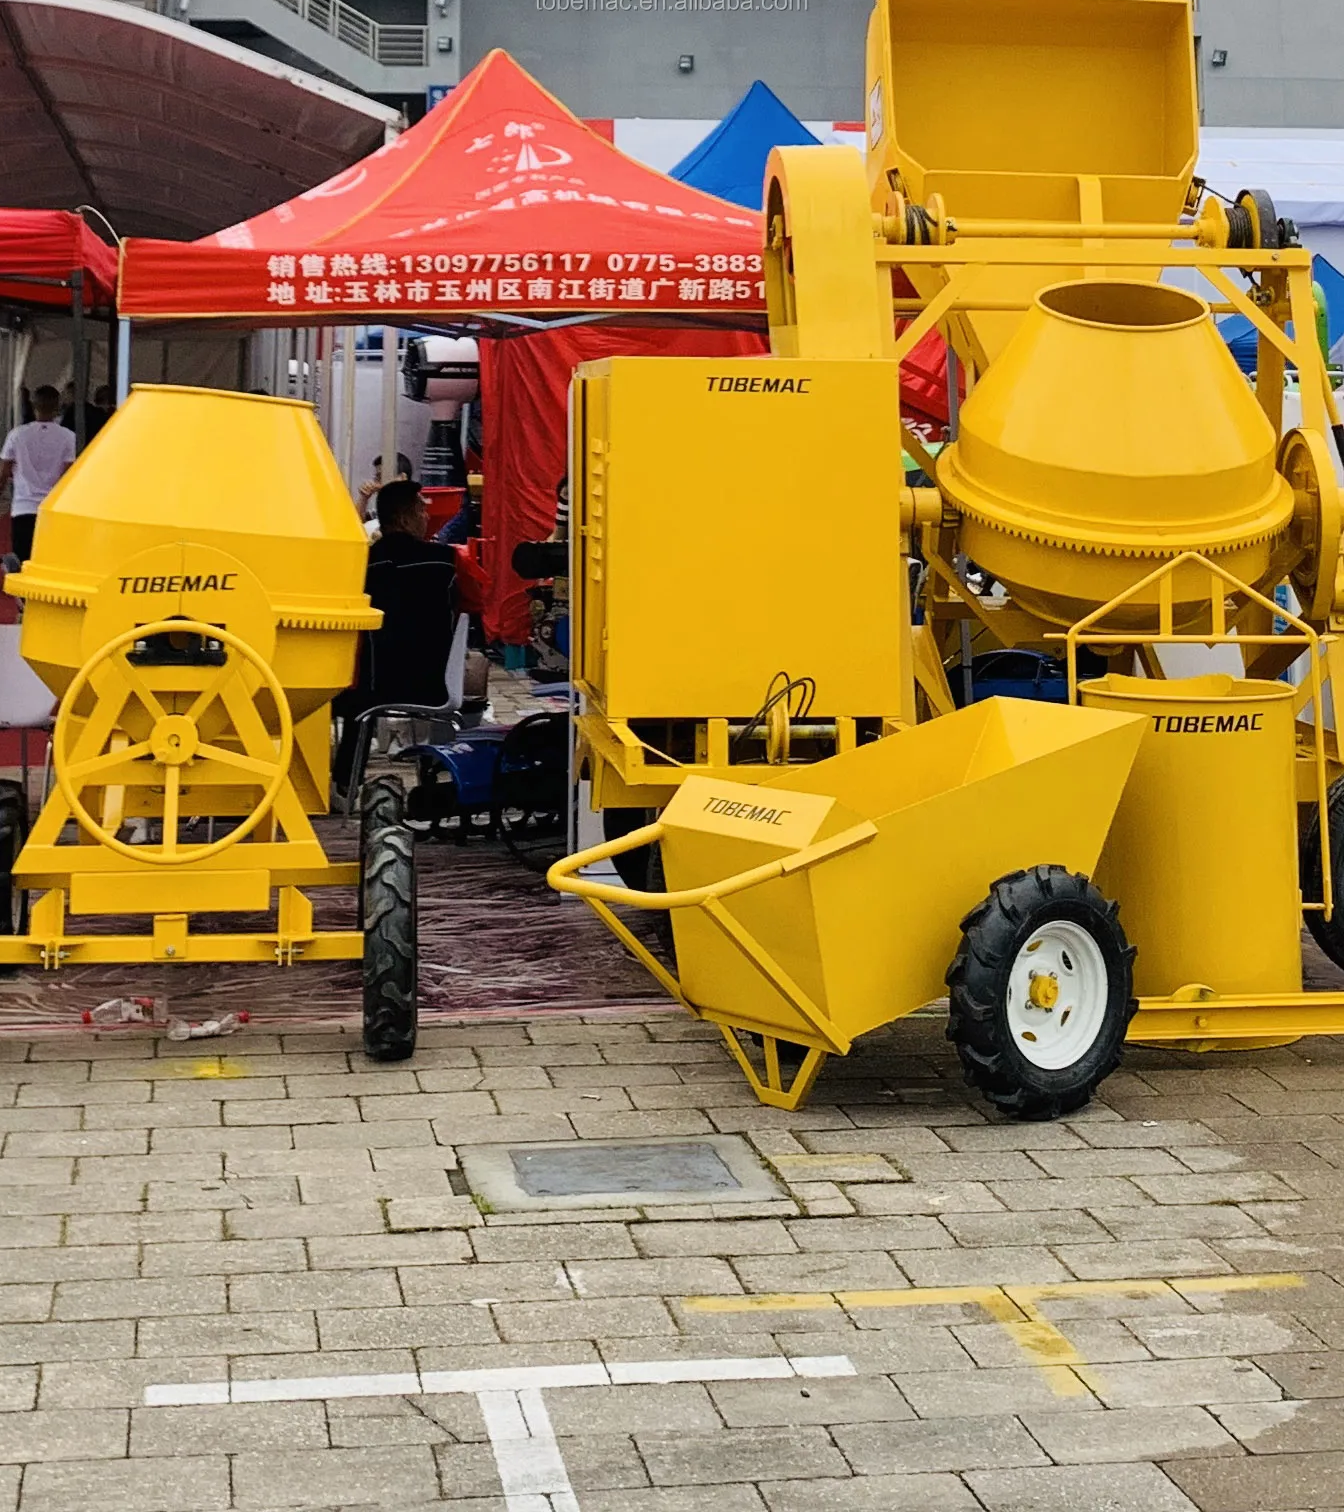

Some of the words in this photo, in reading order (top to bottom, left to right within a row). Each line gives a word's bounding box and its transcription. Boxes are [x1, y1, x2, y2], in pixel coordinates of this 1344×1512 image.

[706, 377, 812, 394] TOBEMAC
[118, 573, 238, 594] TOBEMAC
[1152, 713, 1264, 733] TOBEMAC
[703, 796, 792, 826] TOBEMAC
